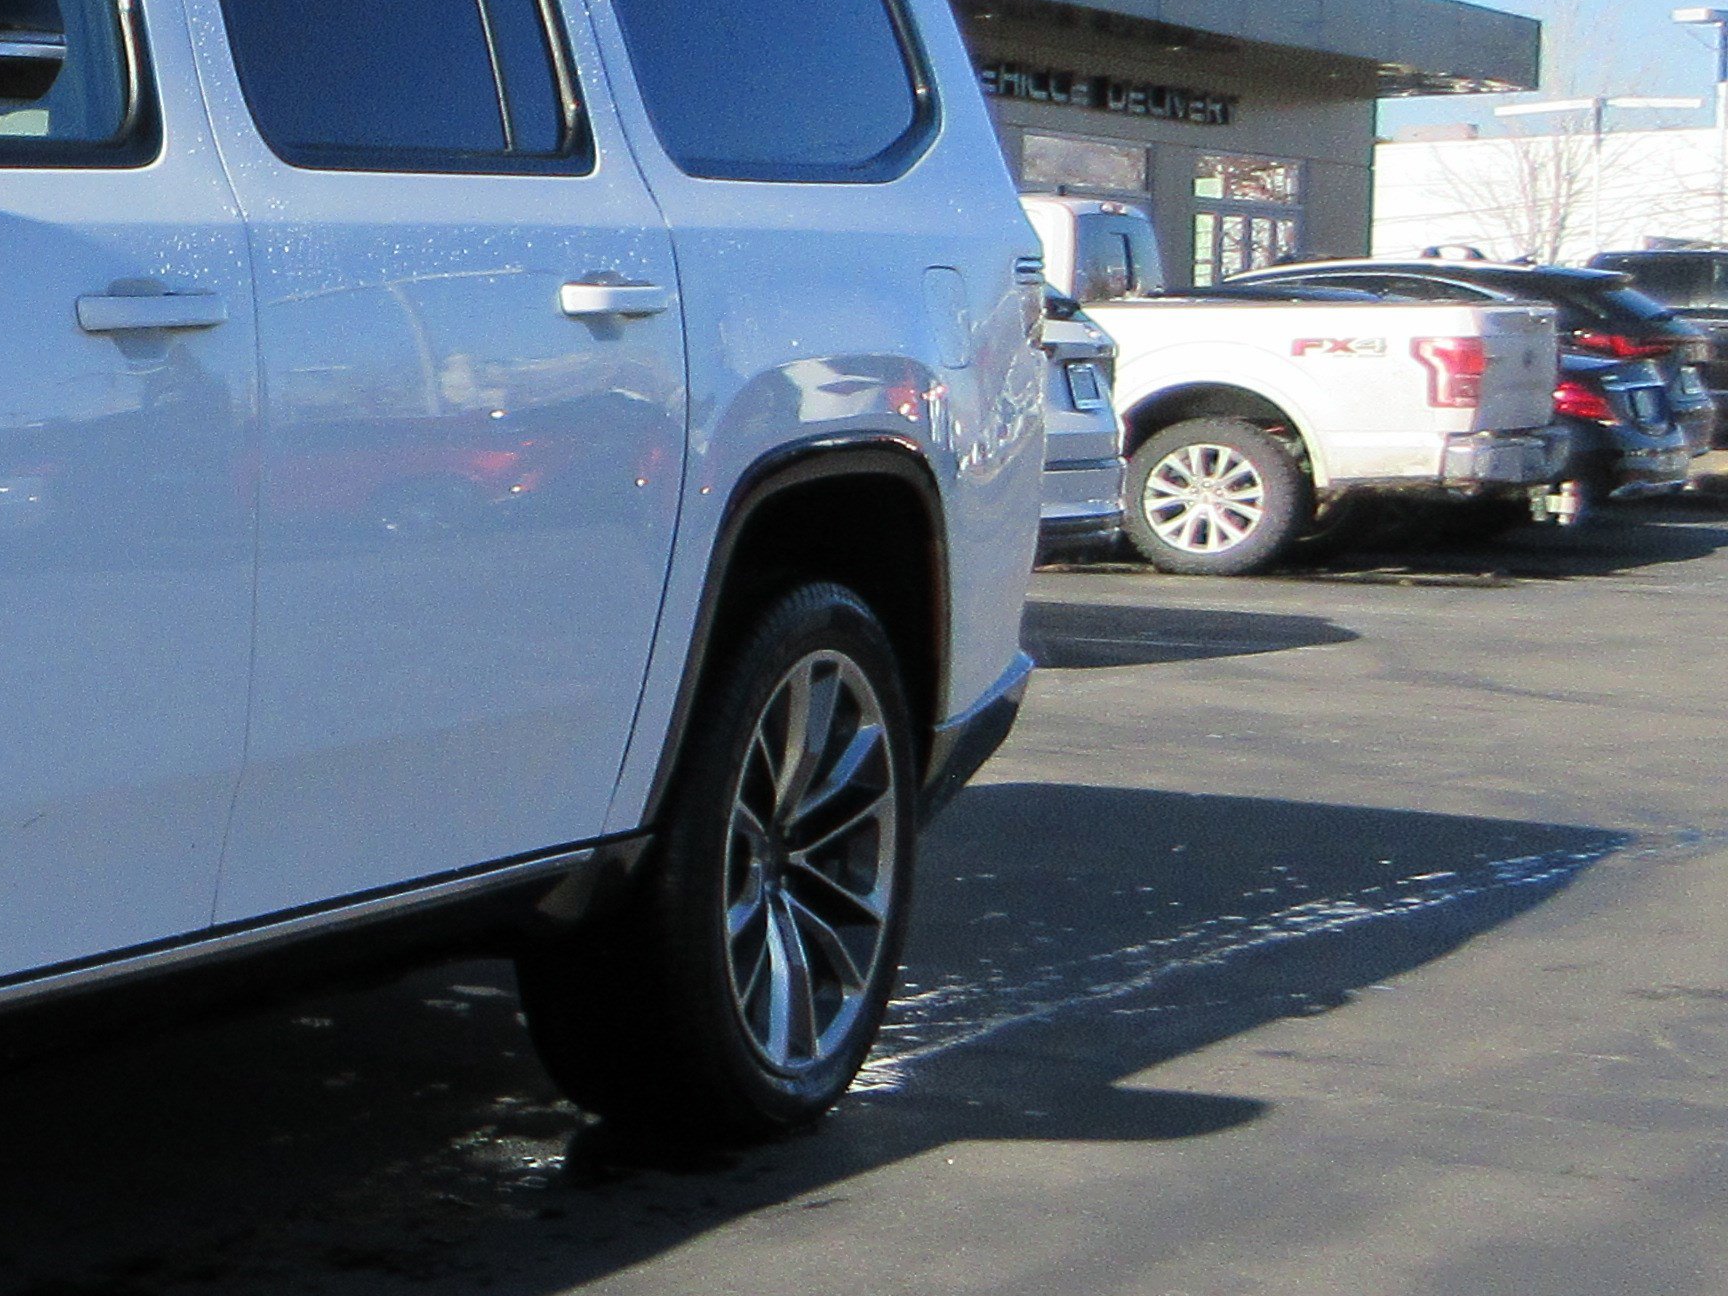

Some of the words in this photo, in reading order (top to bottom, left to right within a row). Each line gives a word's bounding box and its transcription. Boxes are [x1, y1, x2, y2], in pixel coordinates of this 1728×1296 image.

[980, 66, 1089, 106] EHICLE
[1107, 85, 1238, 124] DELIVERY
[1291, 337, 1388, 356] FX4
